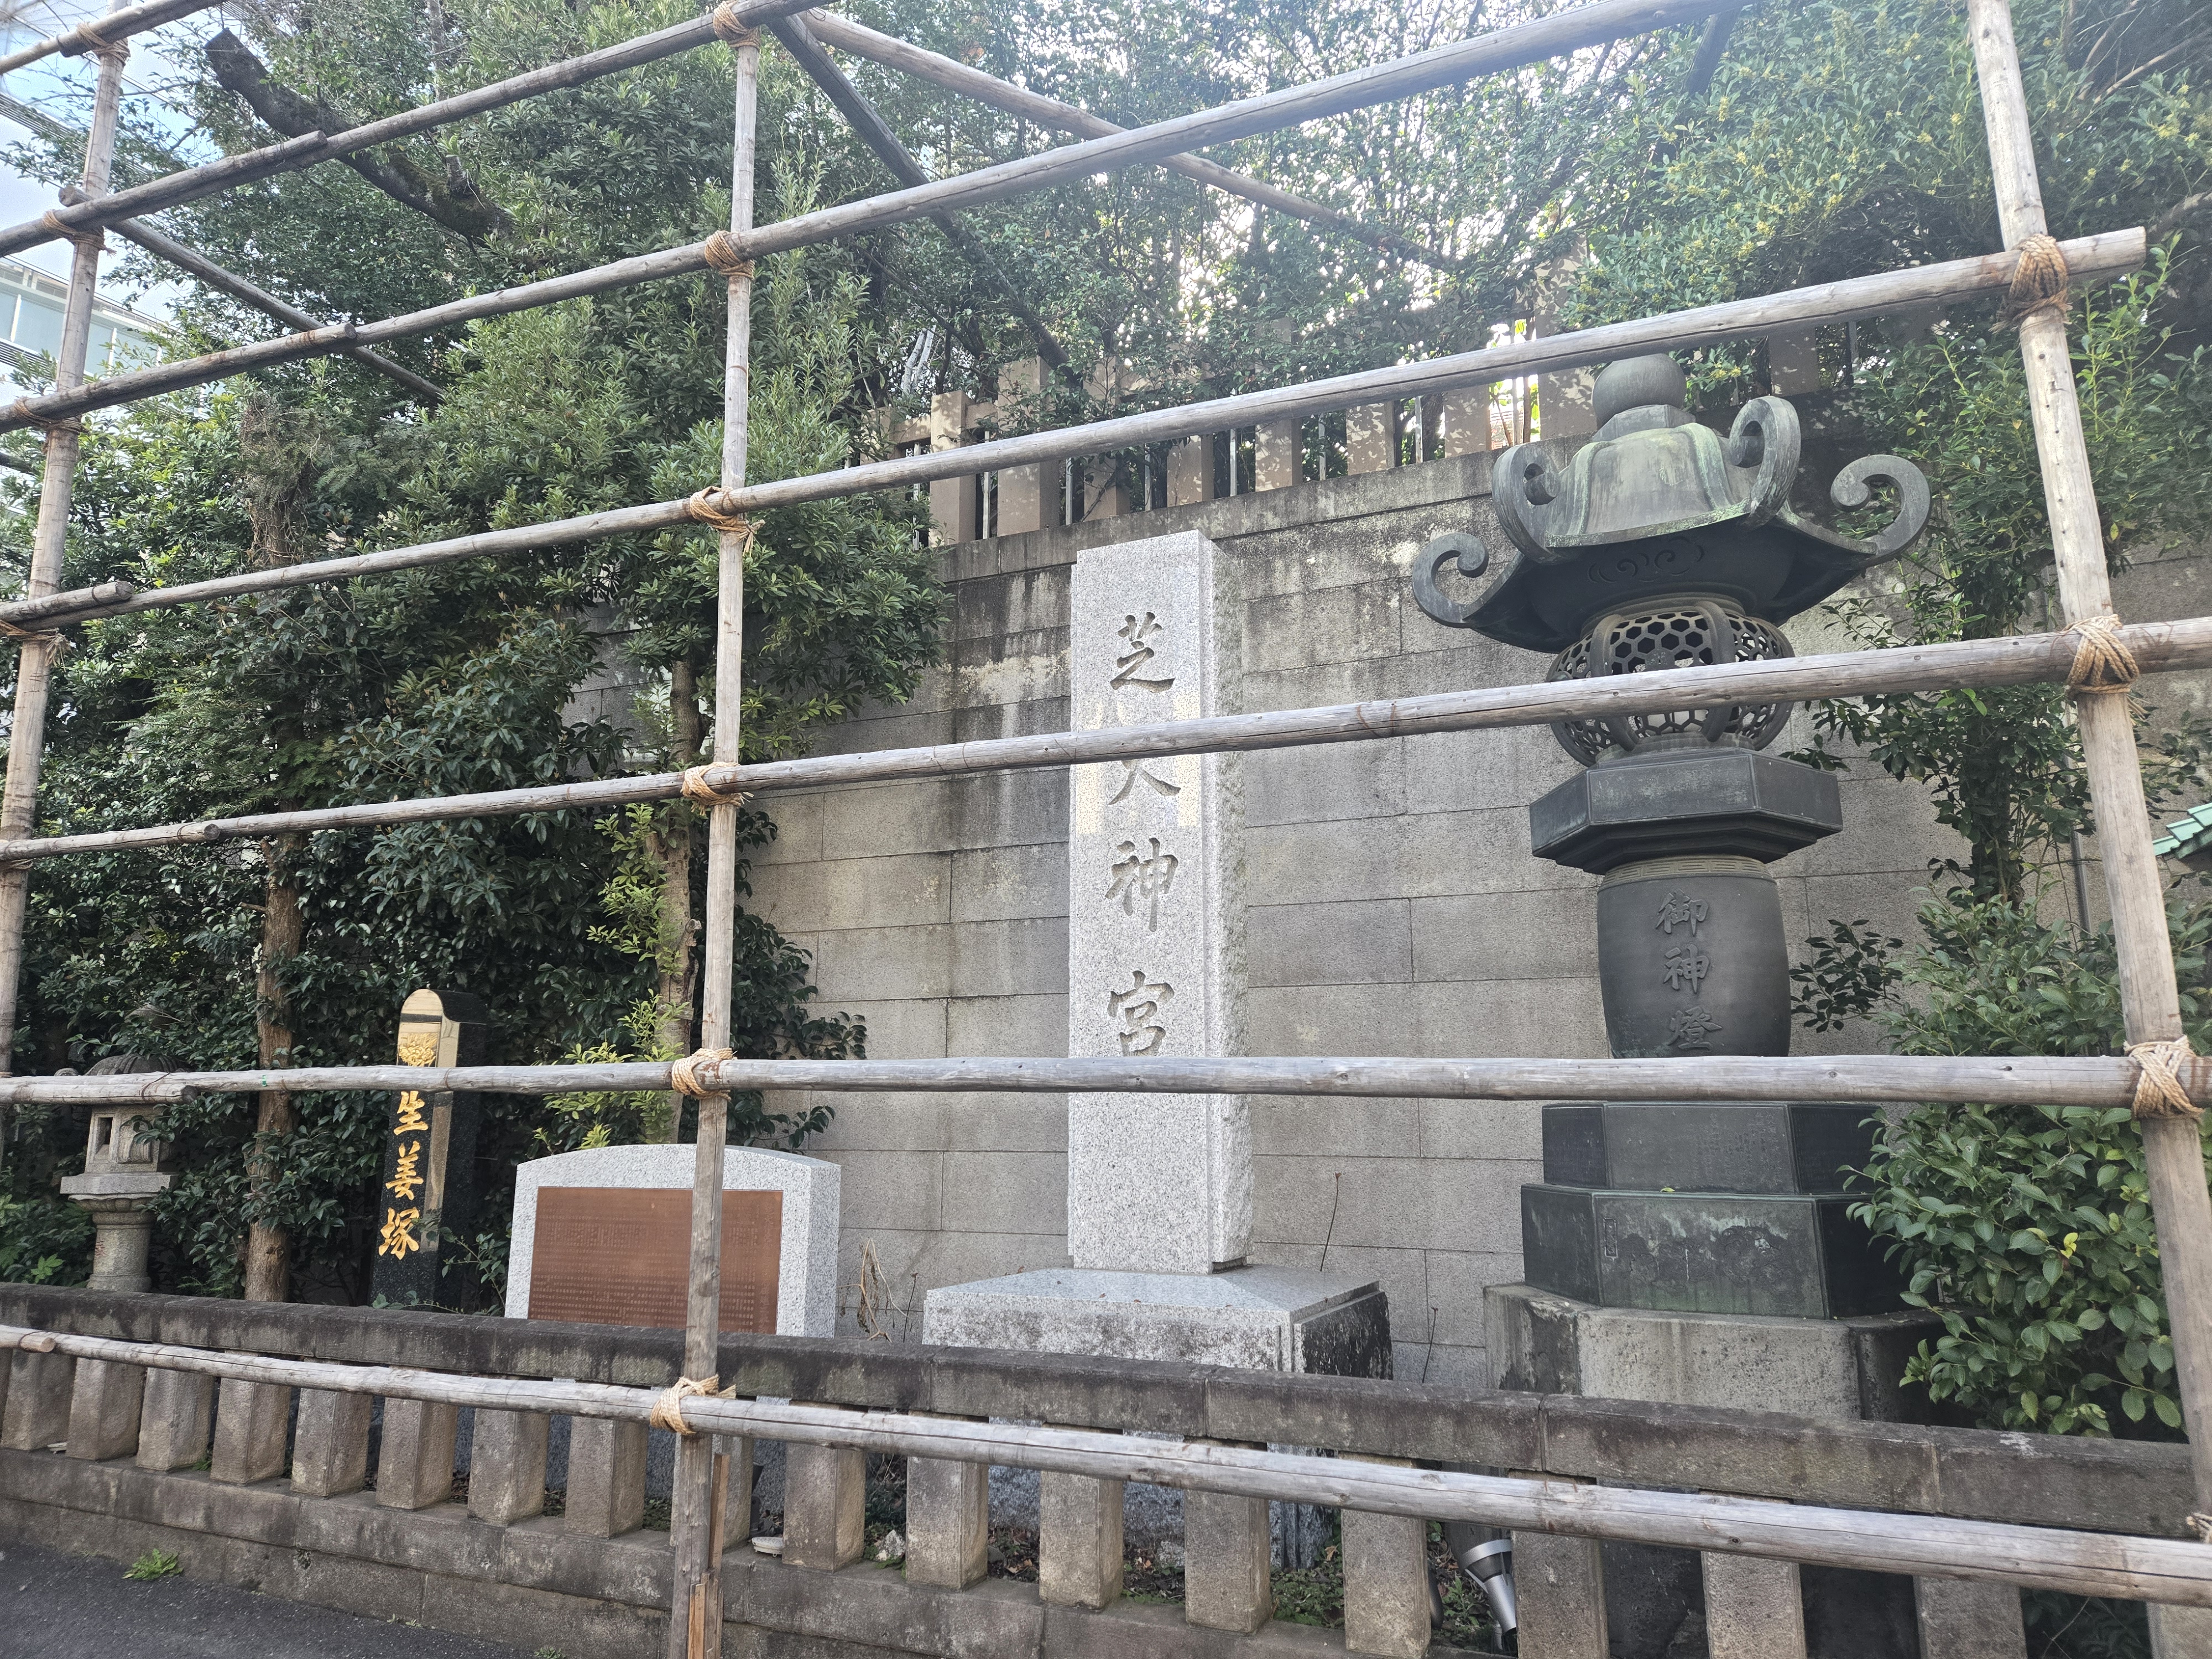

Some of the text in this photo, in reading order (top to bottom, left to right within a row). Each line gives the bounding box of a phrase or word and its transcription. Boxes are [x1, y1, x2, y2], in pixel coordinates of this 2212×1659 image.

[1654, 888, 1723, 1051] 御神燈
[378, 1090, 429, 1260] 生姜塚
